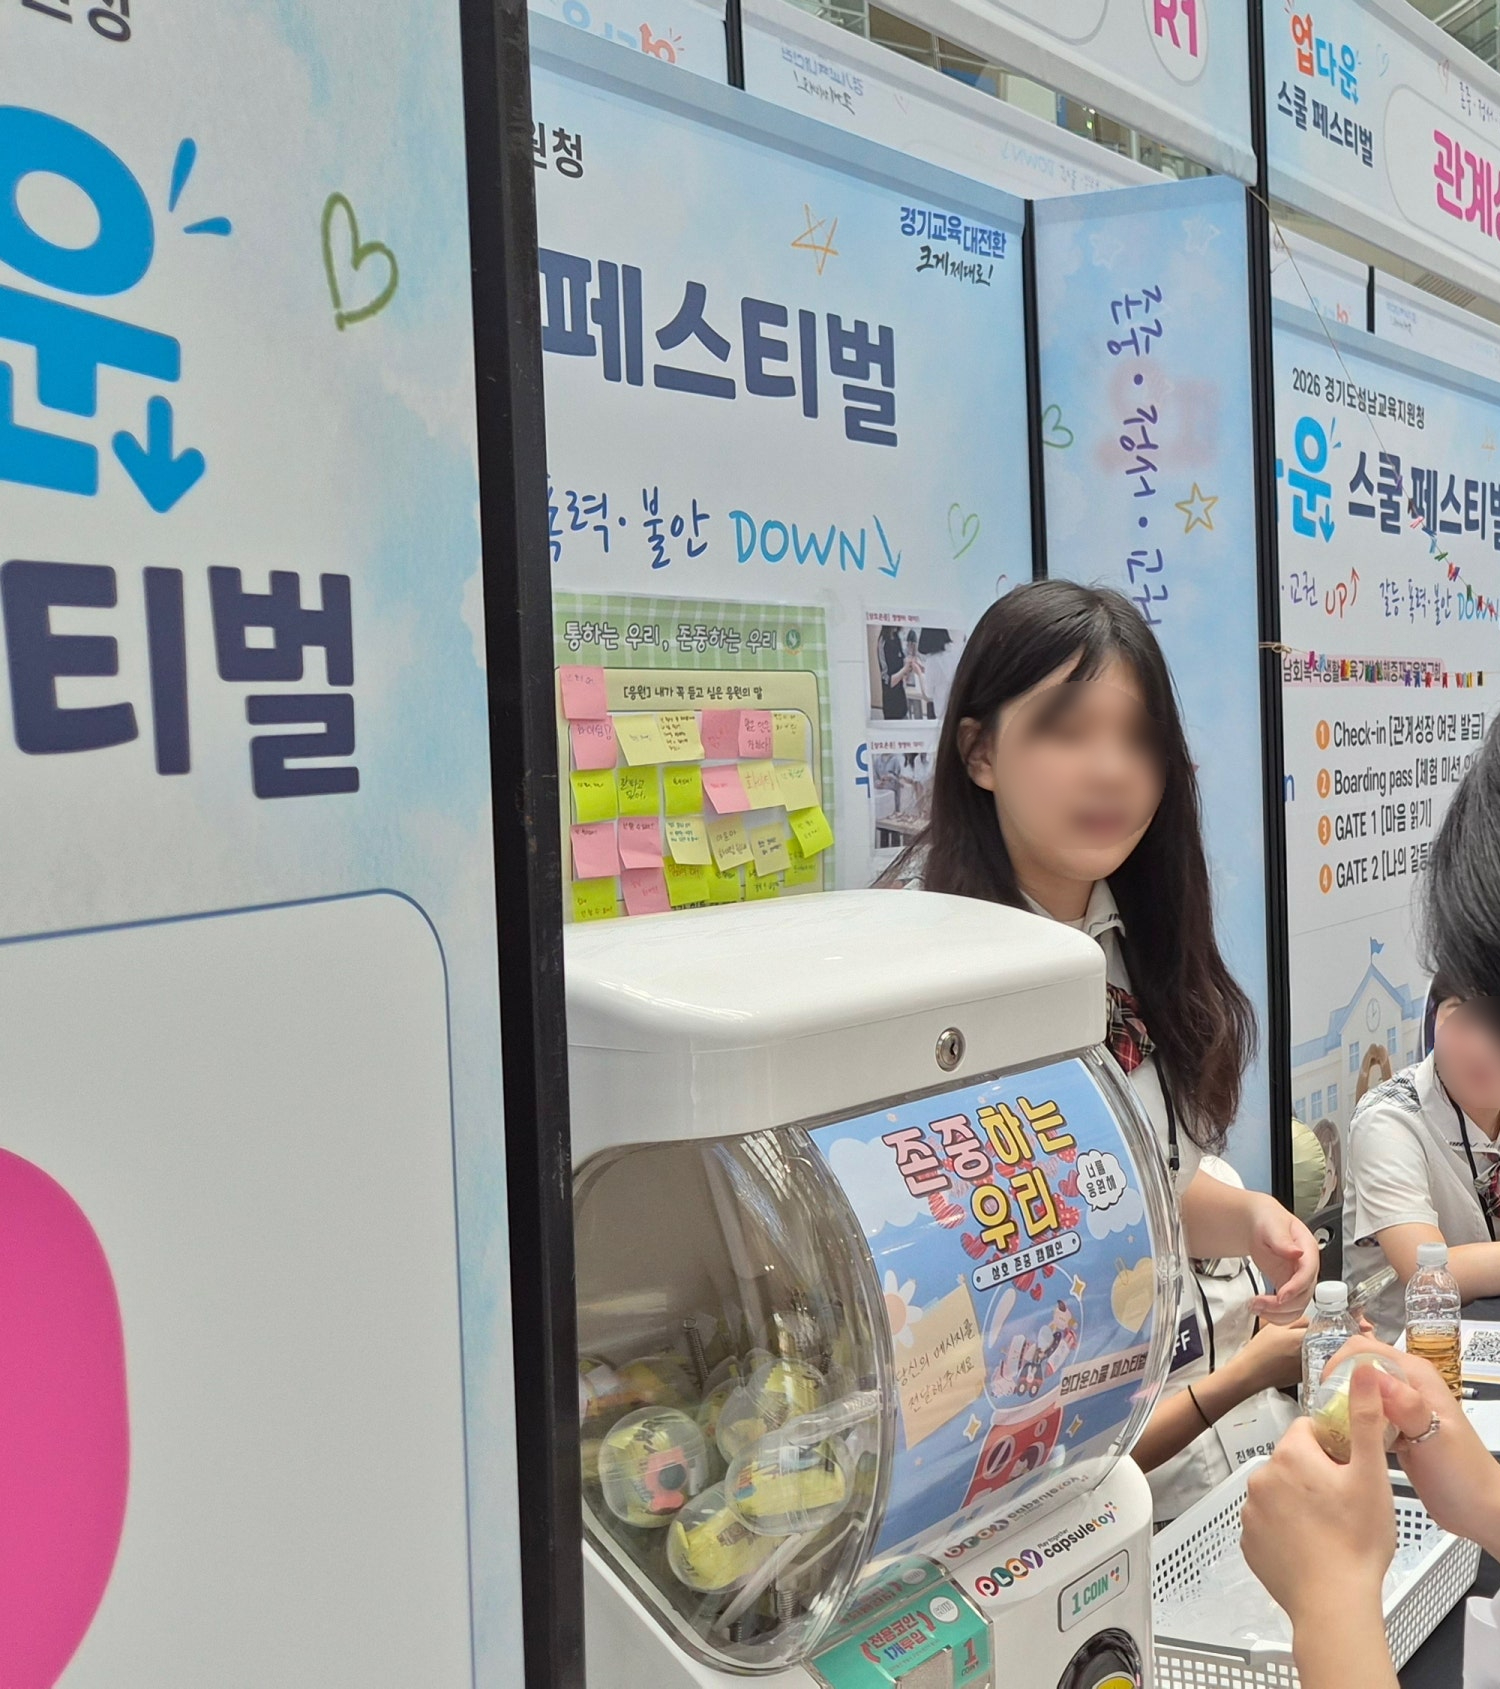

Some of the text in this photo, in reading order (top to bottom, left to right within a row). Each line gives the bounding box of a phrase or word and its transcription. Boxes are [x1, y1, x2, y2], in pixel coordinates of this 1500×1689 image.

[1153, 0, 1199, 58] R1
[1292, 14, 1360, 104] 업다운
[1277, 80, 1374, 168] 스쿨 페스티벌
[916, 245, 950, 277] 크게
[540, 247, 898, 447] 페스티벌
[1293, 367, 1426, 430] 2026 경기도성남교육지원청
[1348, 451, 1403, 535] 스쿨
[730, 509, 866, 572] DOWN
[1325, 582, 1347, 618] UP
[564, 621, 619, 652] 통하는
[676, 624, 741, 654] 존중하는
[747, 629, 777, 654] 우리
[1, 560, 360, 800] 티벌
[1334, 720, 1387, 748] Check-in
[1389, 715, 1435, 746] [관계성장
[1437, 714, 1456, 742] 여권
[1461, 712, 1484, 741] 발급]
[1335, 767, 1387, 797] Boarding
[1389, 768, 1413, 795] pass
[1335, 811, 1367, 841] GATE
[1371, 810, 1377, 835] 1
[1381, 803, 1406, 836] [마음
[1336, 857, 1368, 888] GATE
[1372, 855, 1379, 880] 2
[882, 1096, 1078, 1199] 존중하는
[970, 1166, 1061, 1252] 우리
[991, 1240, 1064, 1281] 상호 존중 캠페인
[1044, 1509, 1117, 1558] capsuletoy
[1072, 1574, 1109, 1615] 1 COIN
[868, 1613, 919, 1649] 전용코인
